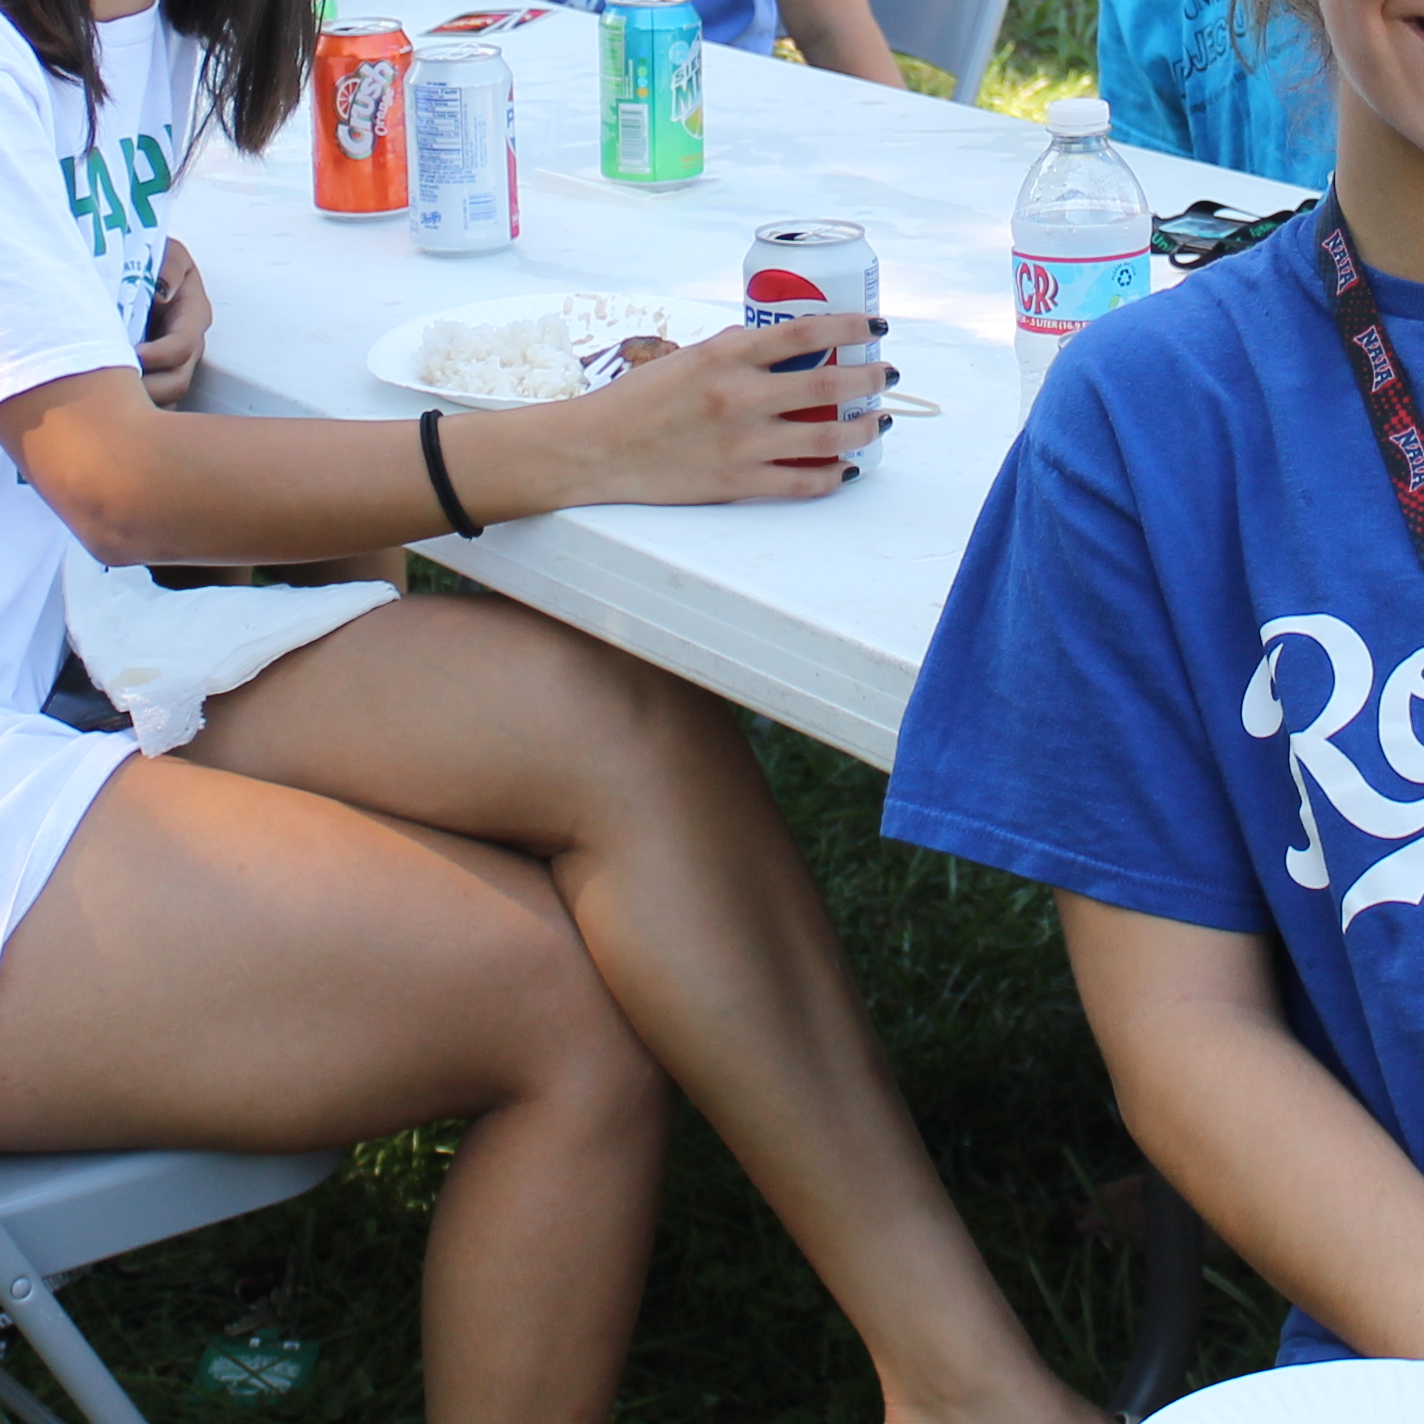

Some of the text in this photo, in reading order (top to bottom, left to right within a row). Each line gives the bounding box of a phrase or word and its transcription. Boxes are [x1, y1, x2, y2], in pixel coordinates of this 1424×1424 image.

[336, 59, 397, 160] Crush
[374, 87, 395, 137] Orange
[1321, 229, 1359, 296] NAIA
[1352, 325, 1395, 393] NAIA
